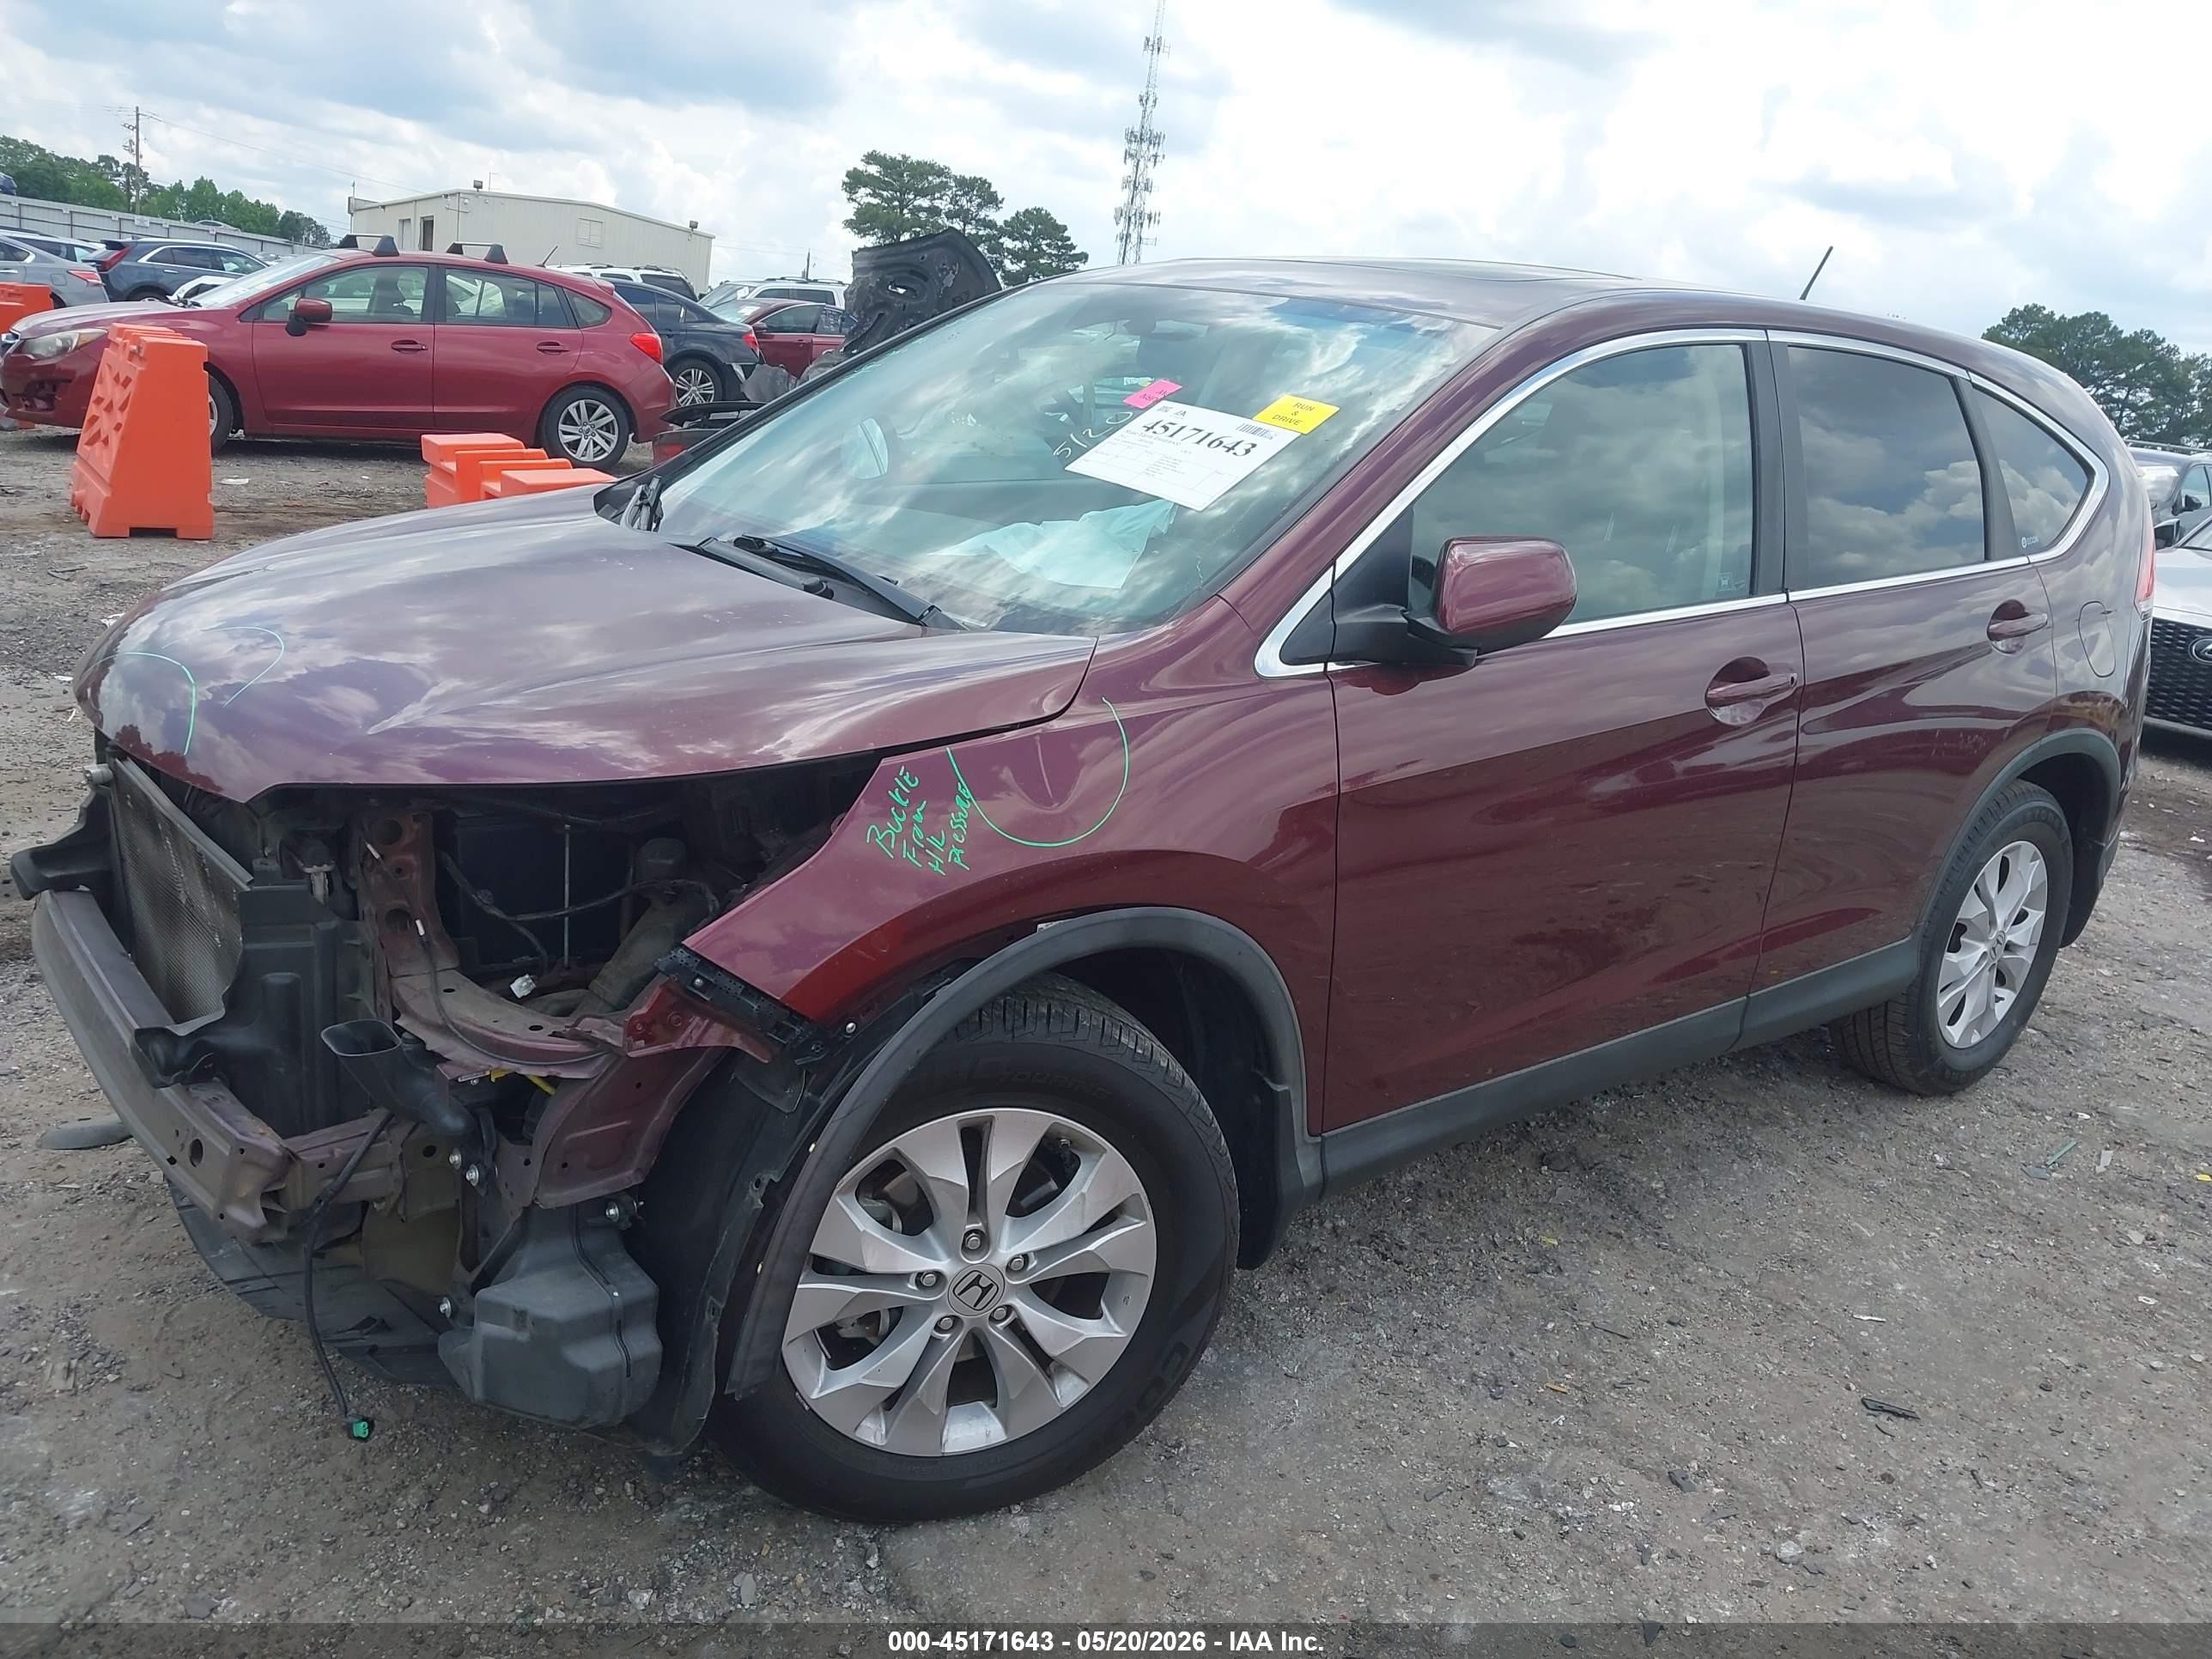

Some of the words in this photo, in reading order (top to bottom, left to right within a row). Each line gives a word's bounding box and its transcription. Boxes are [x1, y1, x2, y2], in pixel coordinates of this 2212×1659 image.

[1292, 402, 1316, 411] RUN
[1272, 414, 1304, 426] DRIVE
[1141, 419, 1258, 457] 45171643
